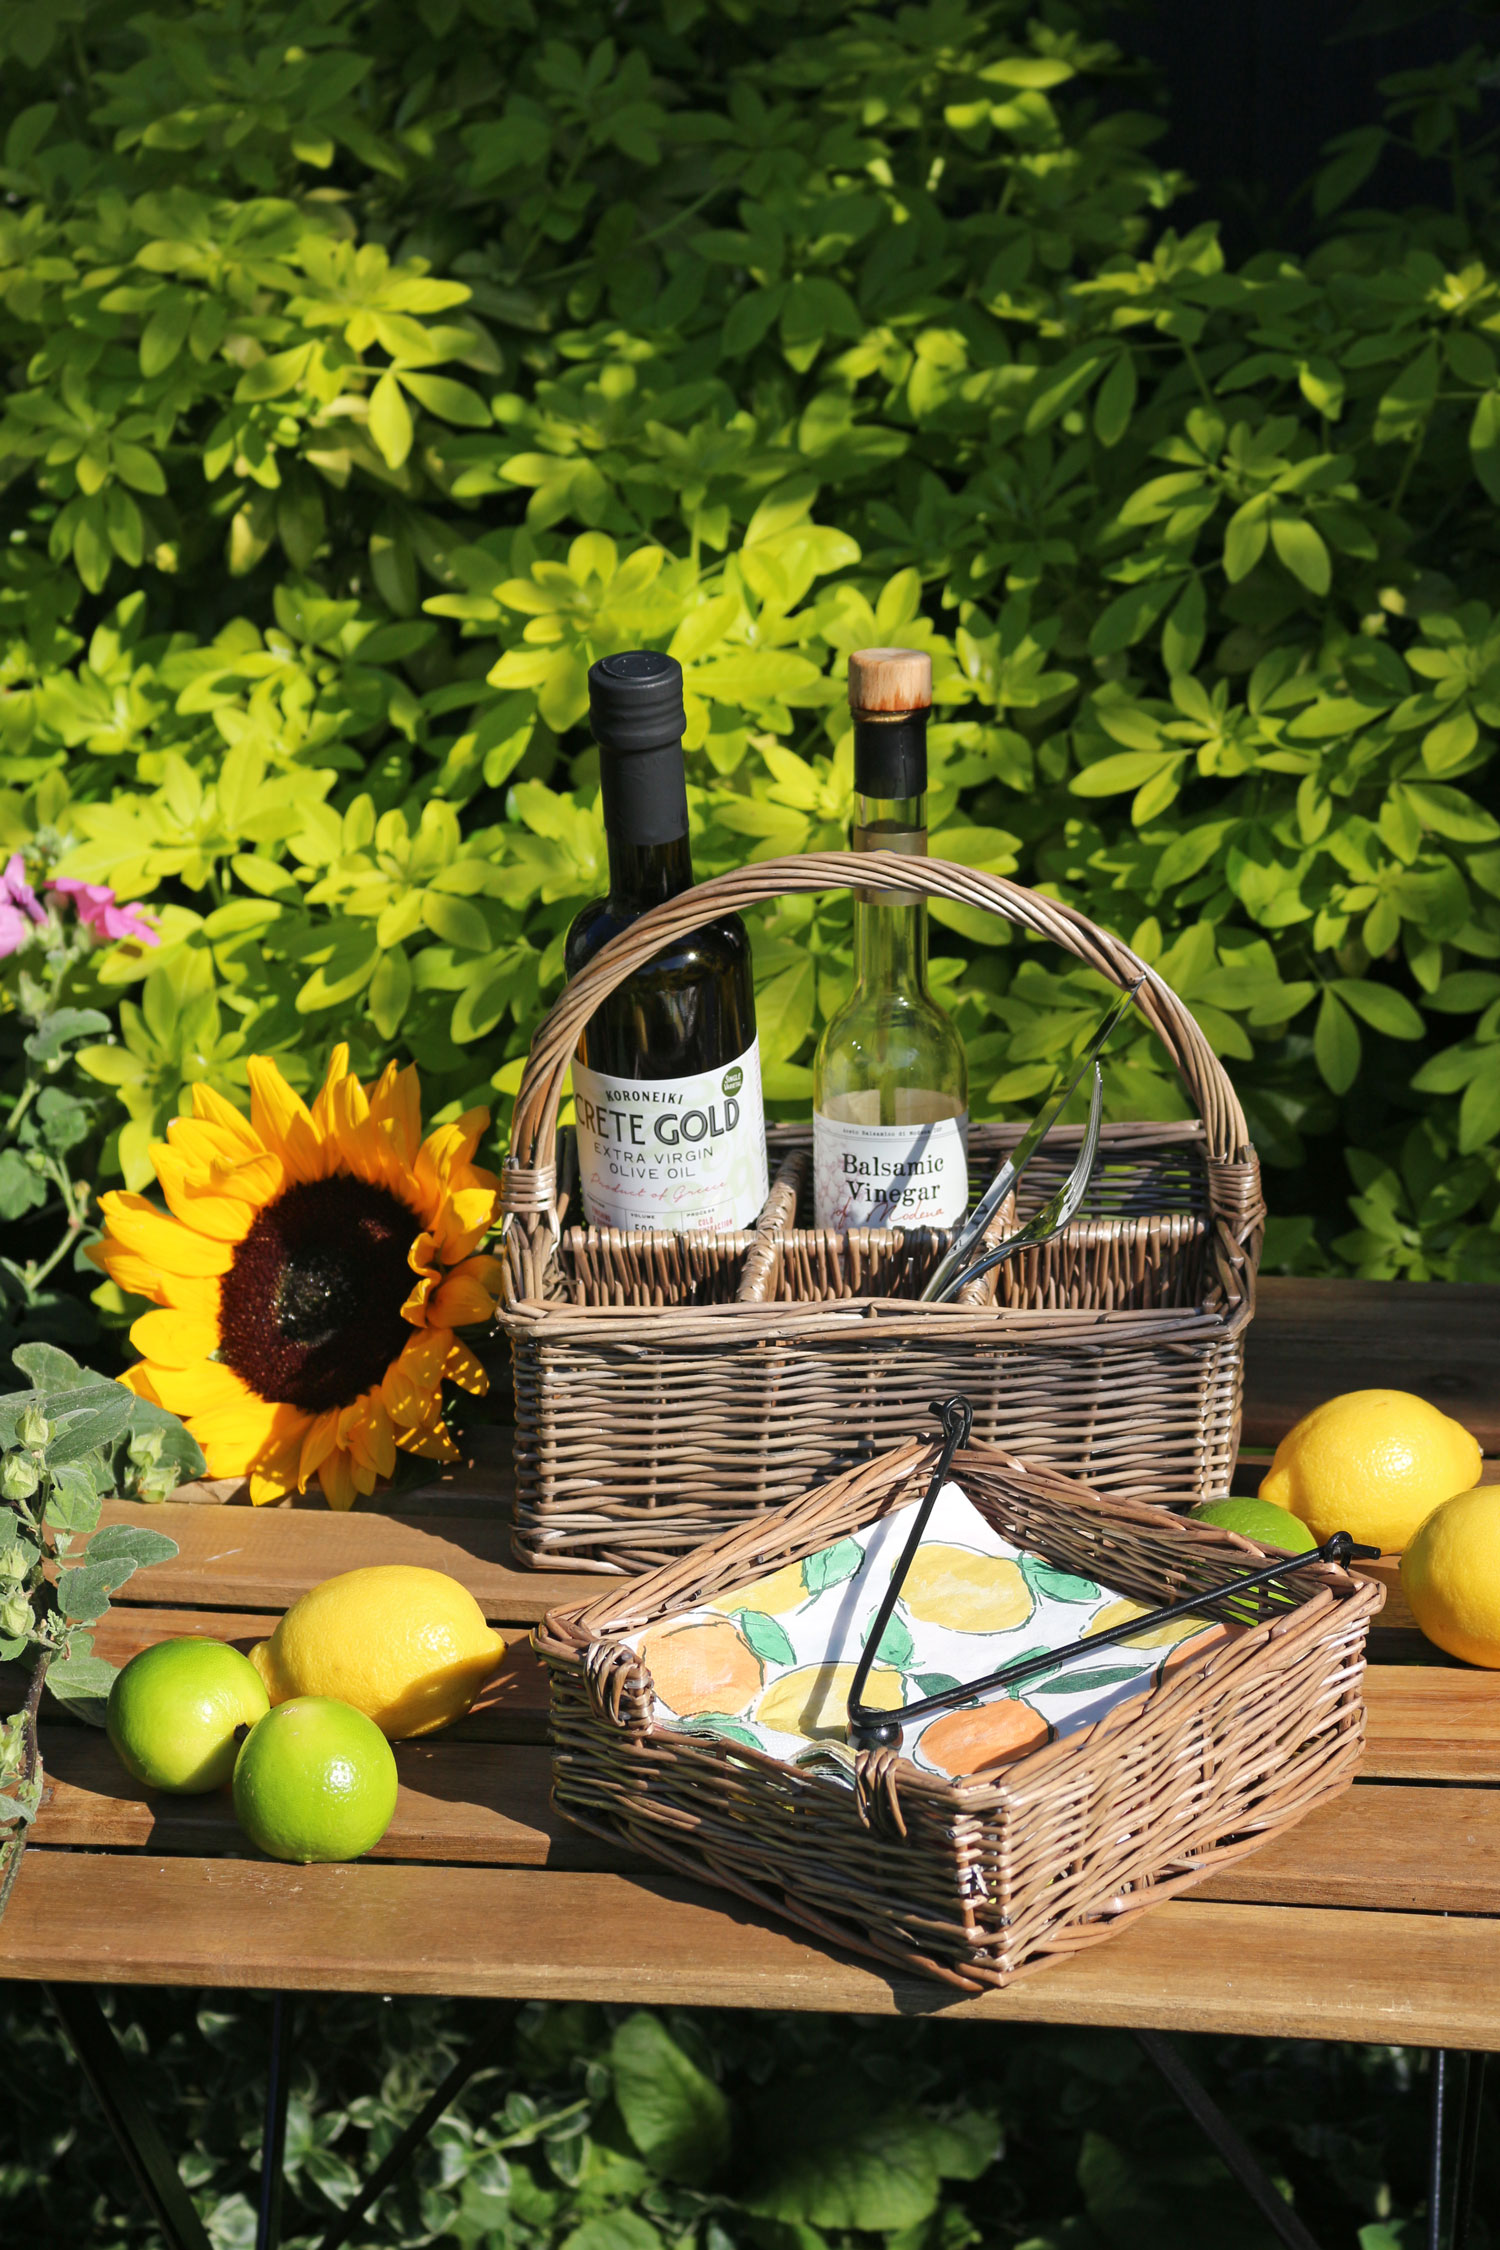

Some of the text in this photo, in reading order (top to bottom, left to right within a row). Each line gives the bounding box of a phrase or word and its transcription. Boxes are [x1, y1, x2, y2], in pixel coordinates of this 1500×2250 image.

[605, 1090, 684, 1105] KORONEIKI
[576, 1093, 740, 1146] CRETE GOLD
[594, 1142, 714, 1165] EXTRA VIRGIN
[842, 1153, 944, 1177] Balsamic
[609, 1162, 696, 1180] OLIVE OIL
[590, 1172, 727, 1203] Product of Greece
[846, 1180, 941, 1207] Vinegar
[630, 1212, 655, 1220] VOLUME
[832, 1197, 945, 1230] of Modena
